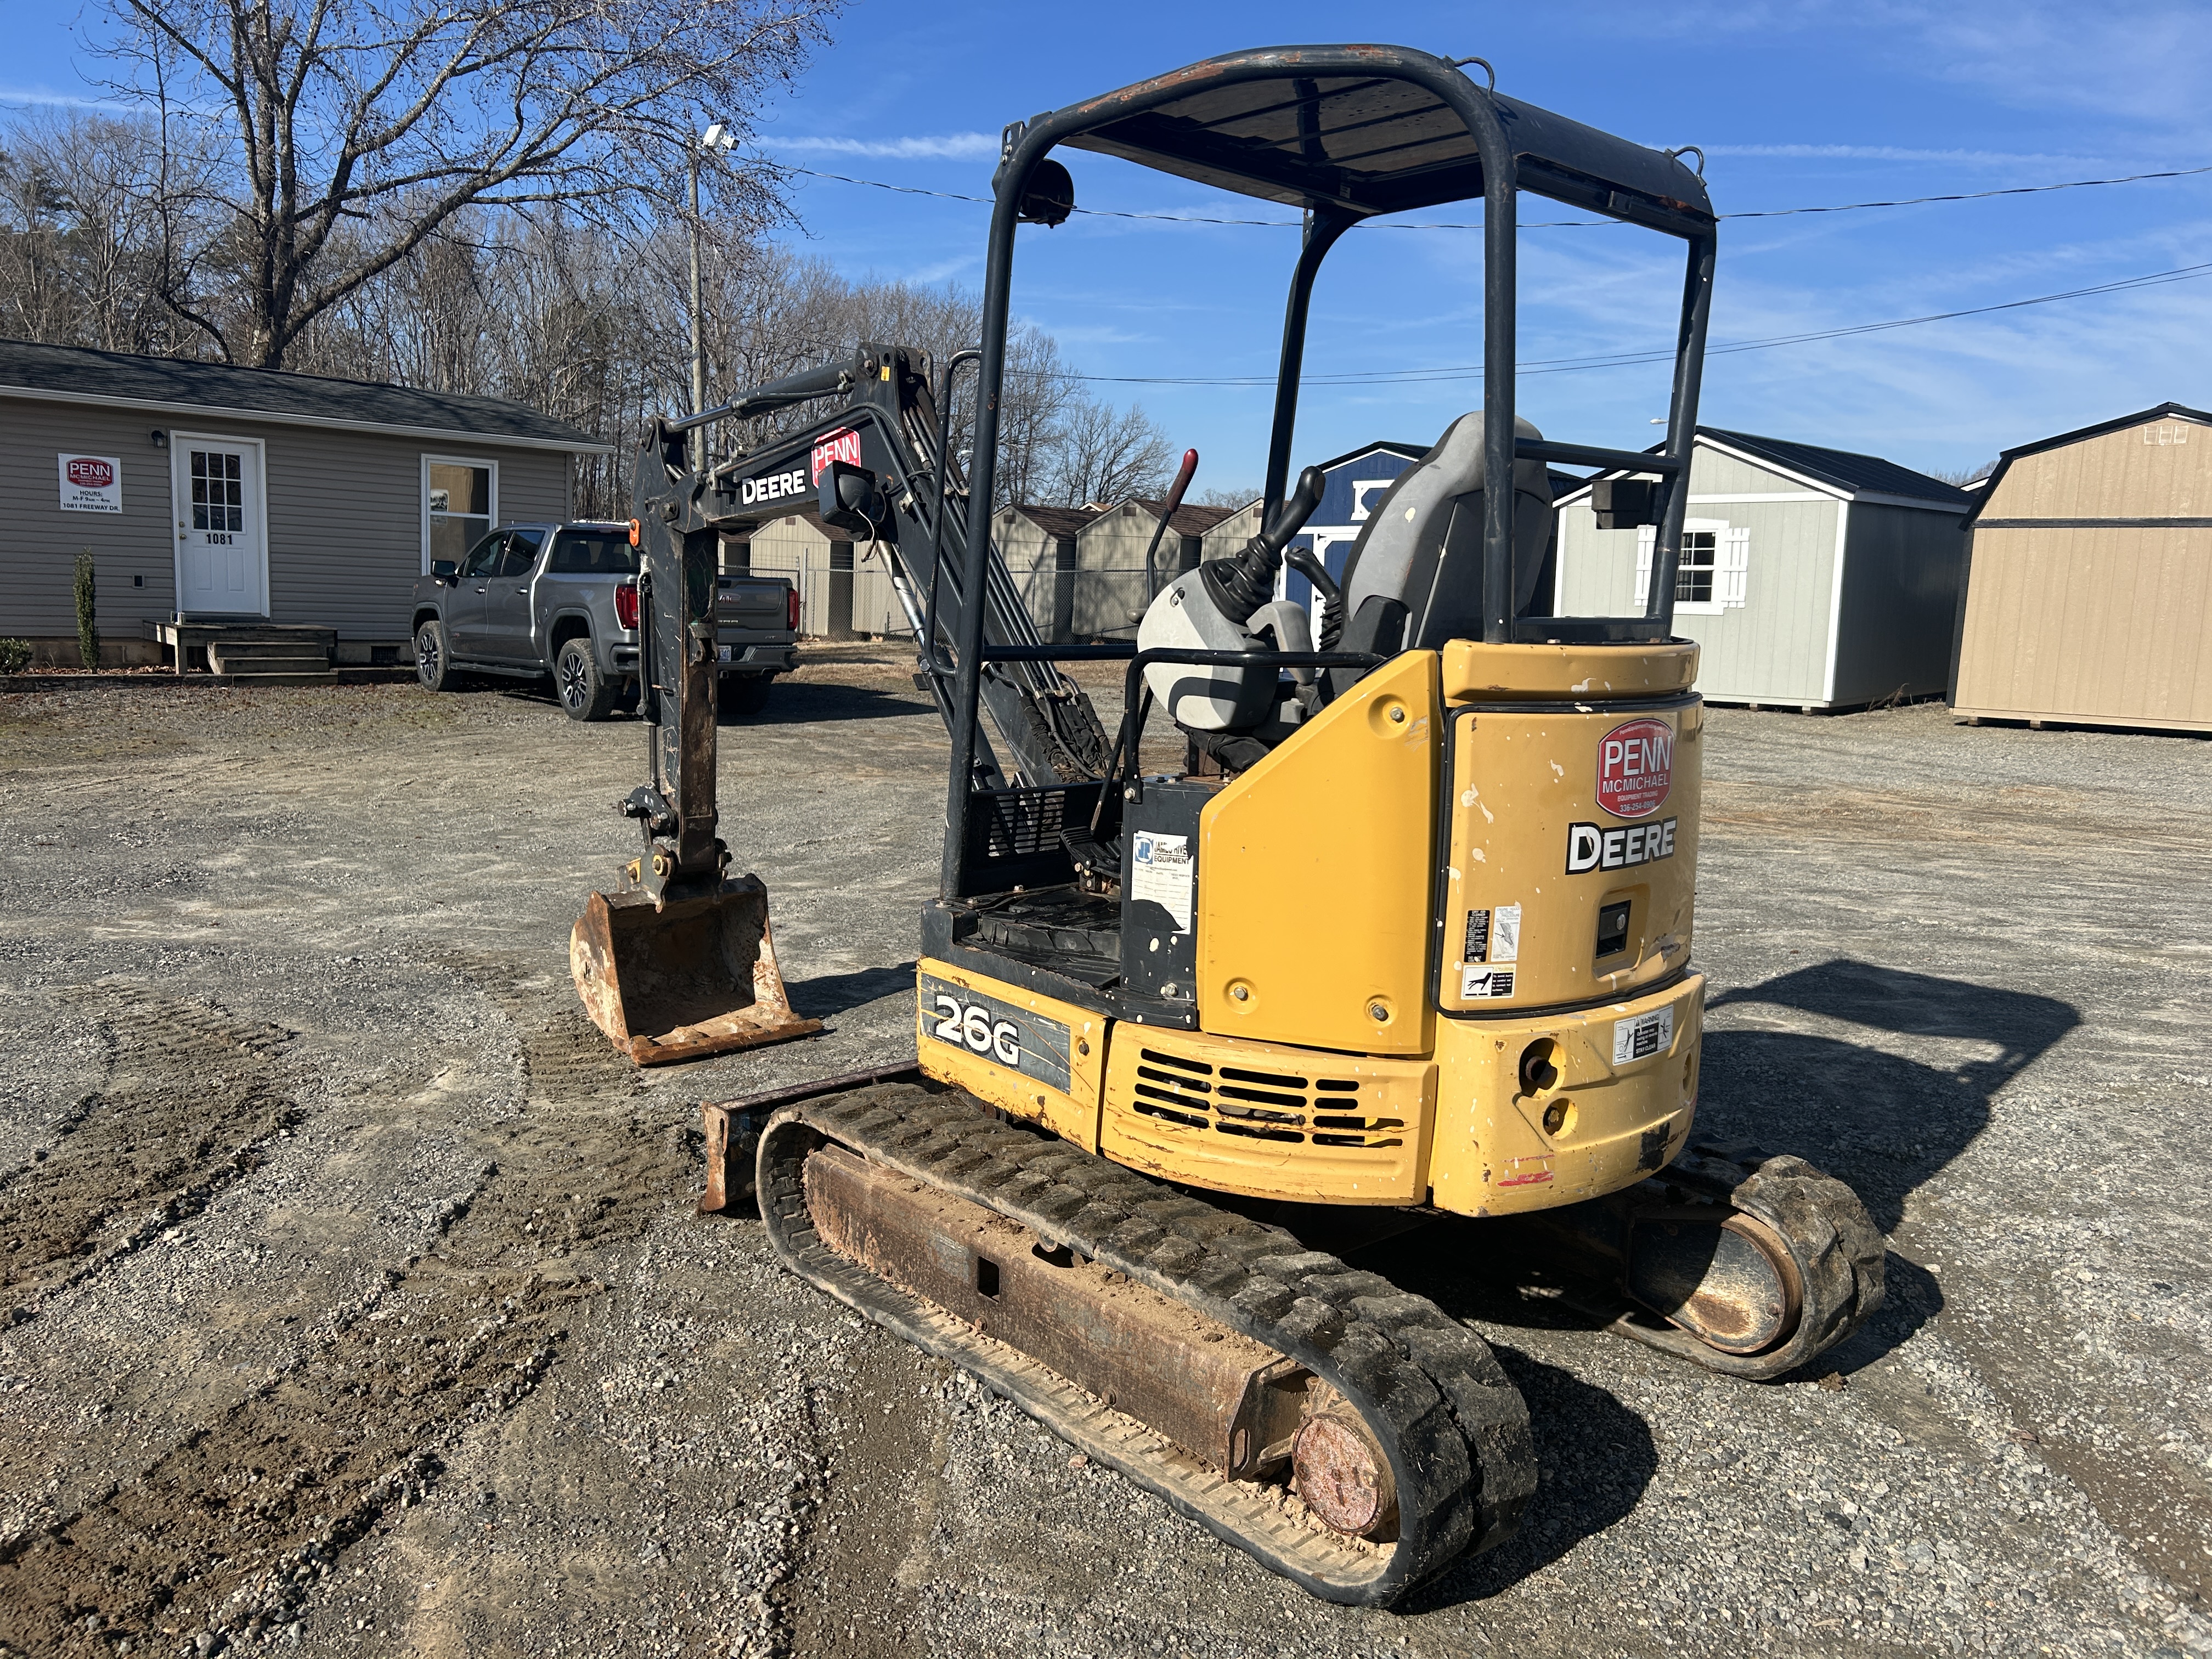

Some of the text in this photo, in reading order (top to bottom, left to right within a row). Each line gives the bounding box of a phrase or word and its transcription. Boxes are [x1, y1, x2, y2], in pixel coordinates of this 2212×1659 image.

[814, 435, 857, 470] PENN
[70, 462, 110, 477] PENN
[742, 469, 806, 505] DEERE
[206, 533, 232, 545] 1081
[1604, 736, 1672, 778] PENN
[1602, 773, 1668, 794] MCMICHAEL
[1617, 793, 1642, 802] EQUIPMENT
[1567, 819, 1677, 872] DEERE
[1154, 855, 1189, 865] EQUIPMENT
[1640, 1014, 1660, 1024] WARNING
[935, 994, 1020, 1066] 26G
[1645, 1043, 1656, 1051] CLEAR
